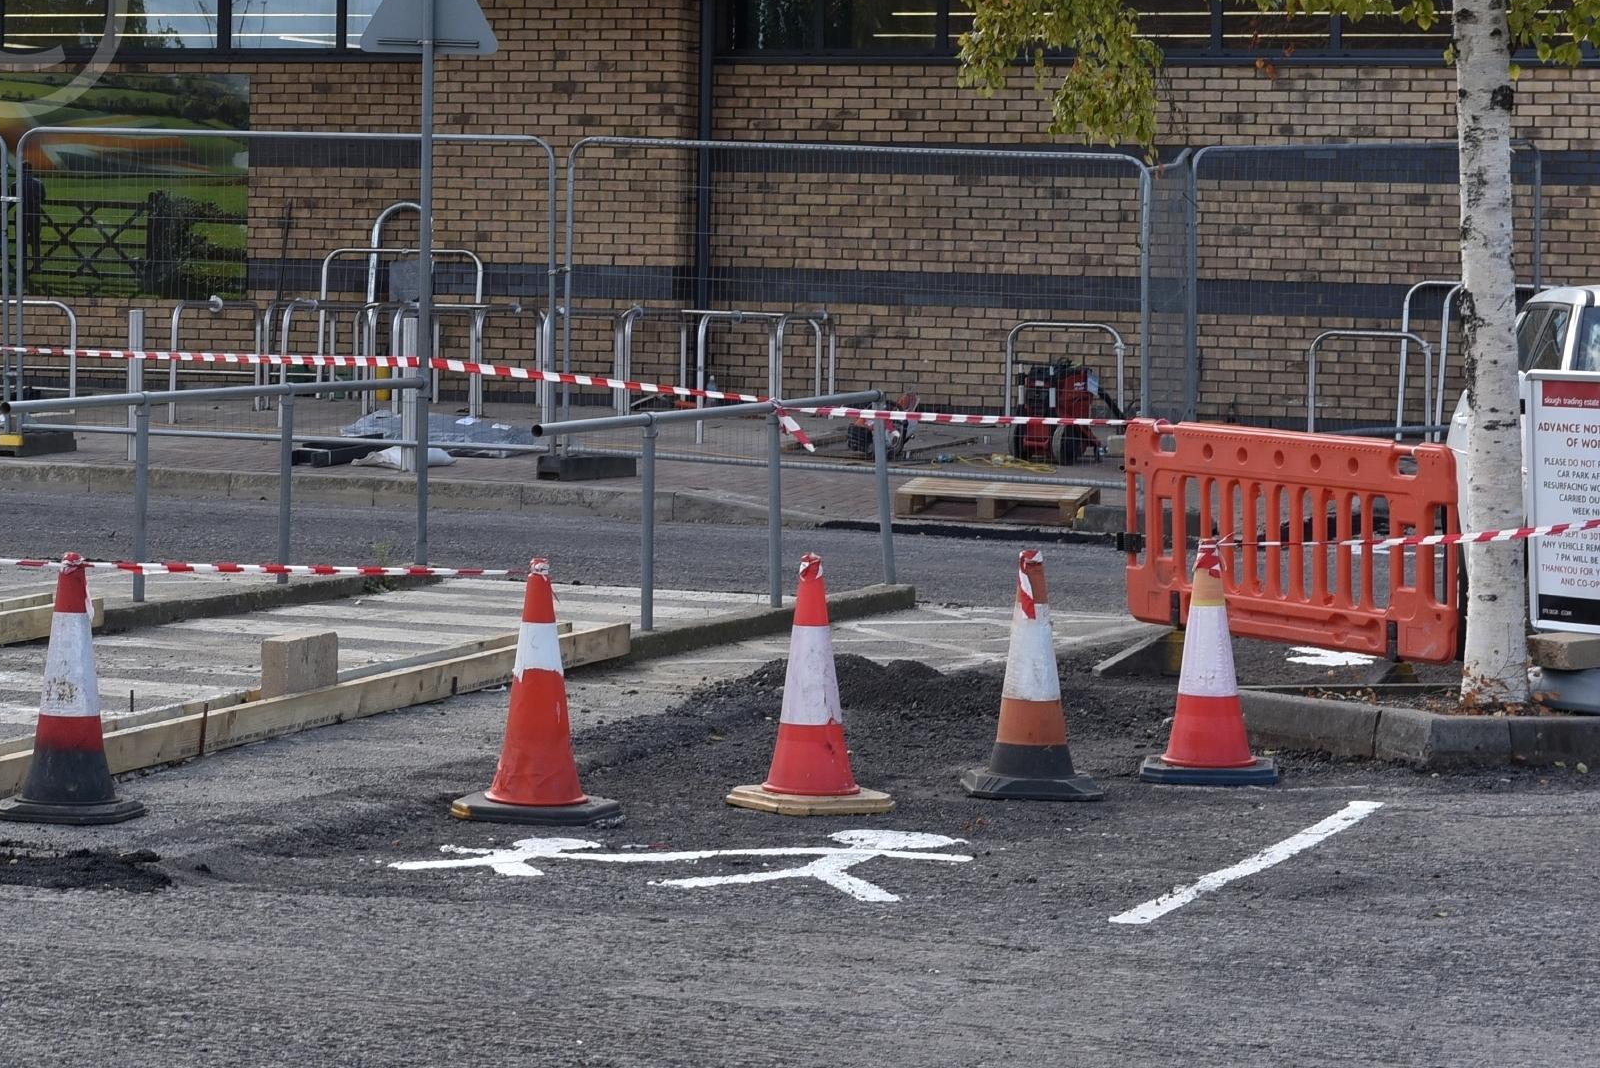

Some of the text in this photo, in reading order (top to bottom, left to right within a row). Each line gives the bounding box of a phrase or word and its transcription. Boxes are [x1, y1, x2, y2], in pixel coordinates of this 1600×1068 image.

[1544, 396, 1600, 406] slough trading estate
[1537, 422, 1581, 433] ADVANCE
[1566, 437, 1579, 448] OF
[1544, 457, 1566, 466] PLEASE
[1568, 458, 1578, 467] DO
[1580, 459, 1596, 468] NOT
[1557, 470, 1570, 478] CAR
[1572, 471, 1590, 479] PARK
[1543, 481, 1588, 492] RESURFACING
[1559, 494, 1587, 503] CARRIED
[1571, 507, 1591, 516] WEEK
[1541, 540, 1556, 549] ANY
[1557, 541, 1585, 552] VEHICLE
[1561, 553, 1571, 562] PM
[1572, 554, 1588, 564] WILL
[1590, 556, 1599, 564] BE
[1541, 564, 1578, 575] THANKYOU
[1580, 566, 1594, 576] FOR
[1560, 577, 1575, 586] AND
